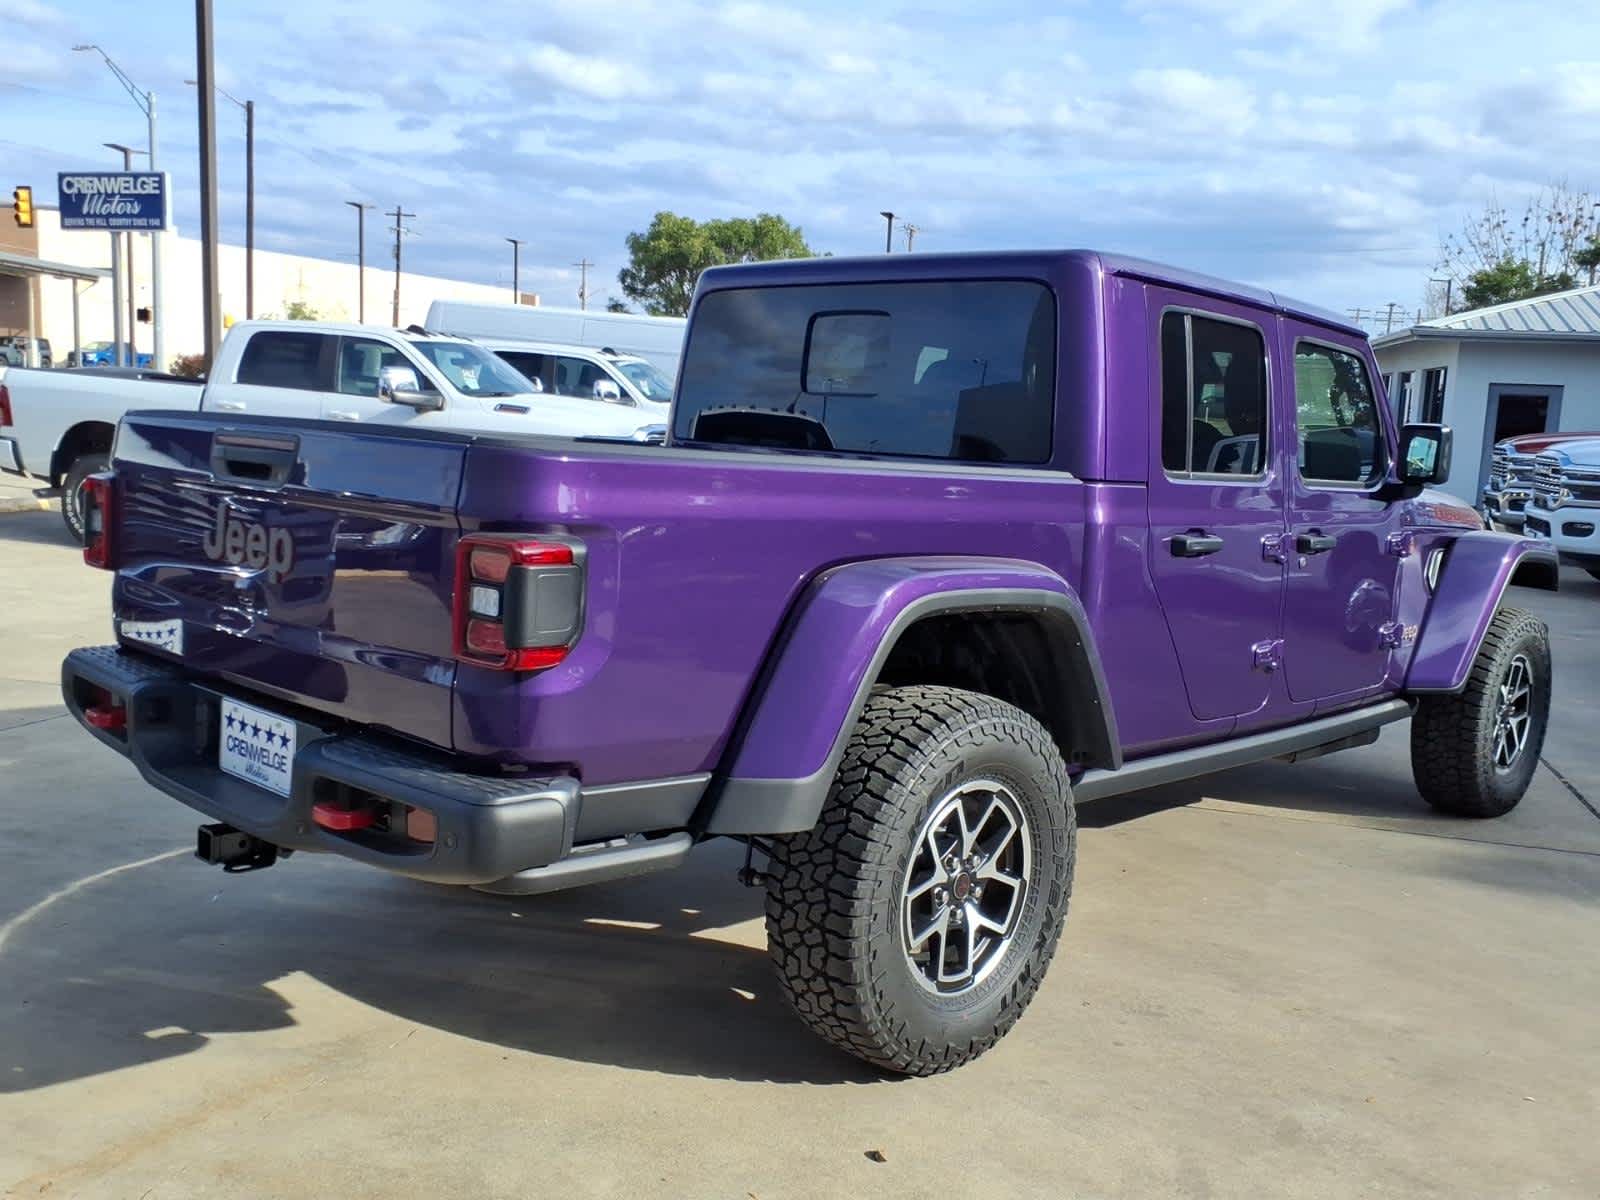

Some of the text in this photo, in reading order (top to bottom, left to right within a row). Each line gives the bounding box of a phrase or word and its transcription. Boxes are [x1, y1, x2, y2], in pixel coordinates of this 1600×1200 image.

[62, 176, 161, 195] CRENWELGE
[81, 194, 142, 215] Motors
[203, 502, 293, 584] Jeep
[226, 734, 288, 774] CRENWELGE
